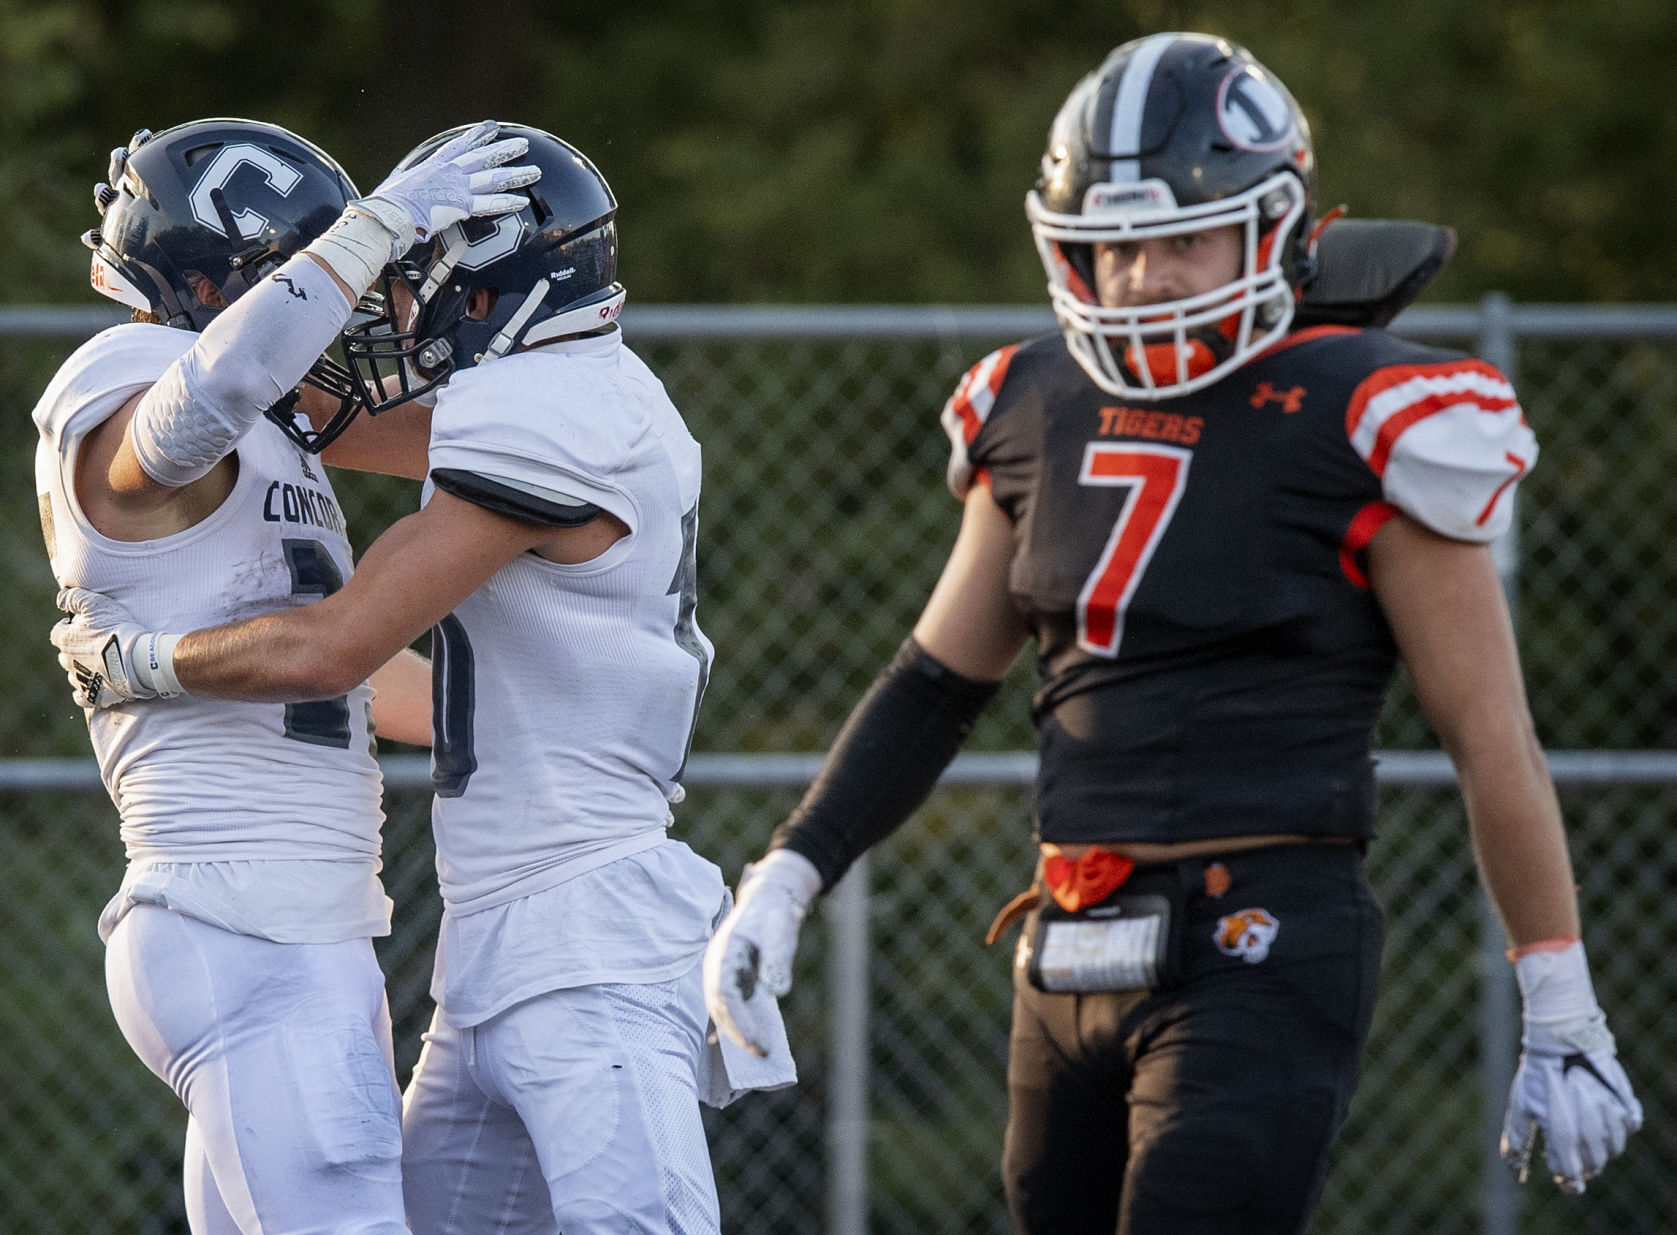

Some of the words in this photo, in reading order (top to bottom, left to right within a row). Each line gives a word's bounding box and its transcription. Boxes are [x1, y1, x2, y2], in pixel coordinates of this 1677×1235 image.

[188, 143, 304, 241] C
[1098, 406, 1204, 445] TIGERS
[263, 480, 346, 537] CONCOR
[1077, 441, 1194, 660] 7
